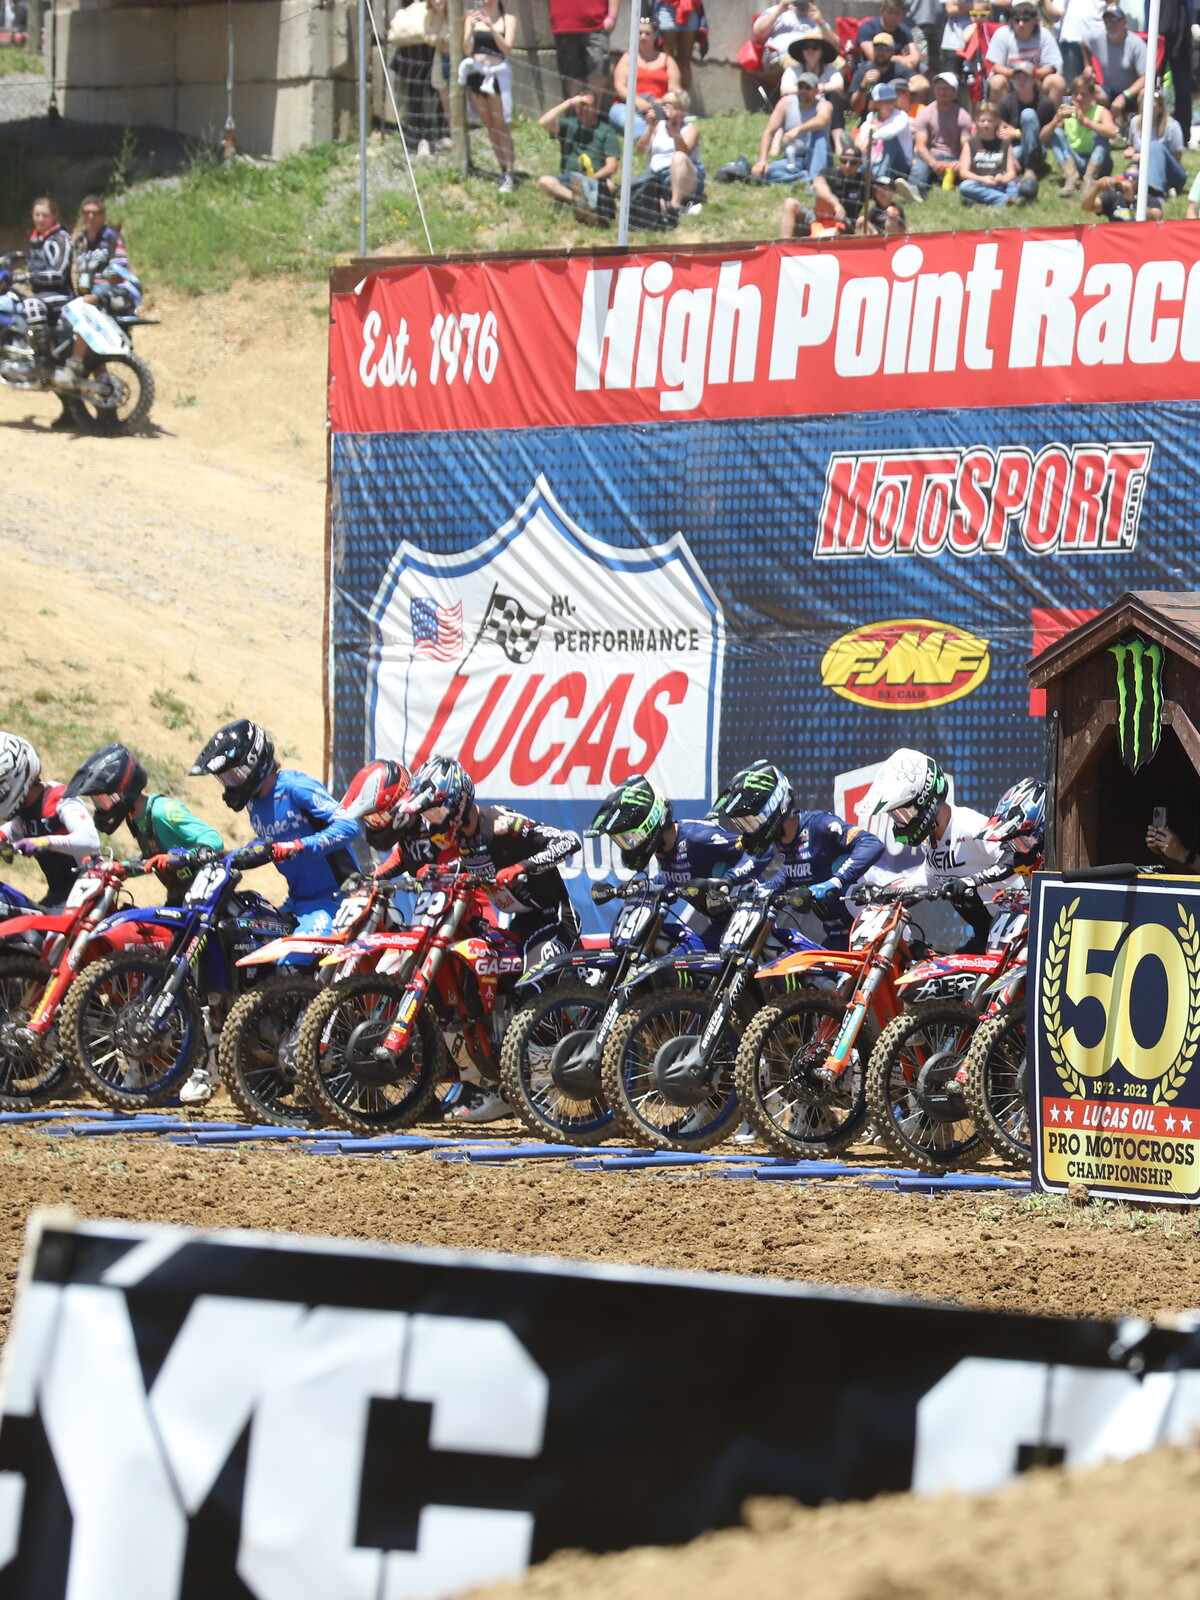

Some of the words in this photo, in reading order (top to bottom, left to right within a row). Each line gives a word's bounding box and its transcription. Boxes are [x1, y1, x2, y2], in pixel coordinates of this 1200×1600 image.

[575, 260, 761, 412] High
[768, 242, 1003, 381] Point
[359, 310, 417, 387] Est.
[429, 310, 498, 386] 1976
[553, 628, 700, 652] PERFORMANCE
[822, 630, 989, 687] FMF
[410, 671, 690, 787] LUCAS
[925, 850, 967, 872] NEAL
[475, 958, 523, 974] GASG
[1059, 918, 1191, 1081] 50
[1092, 1080, 1115, 1095] 1972
[1123, 1083, 1148, 1098] 2022
[1082, 1104, 1129, 1129] LUCAS
[1131, 1108, 1156, 1131] OIL
[1048, 1132, 1080, 1156] PRO
[1085, 1136, 1195, 1166] MOTOCROSS
[1066, 1161, 1173, 1186] CHAMPIONSHIP
